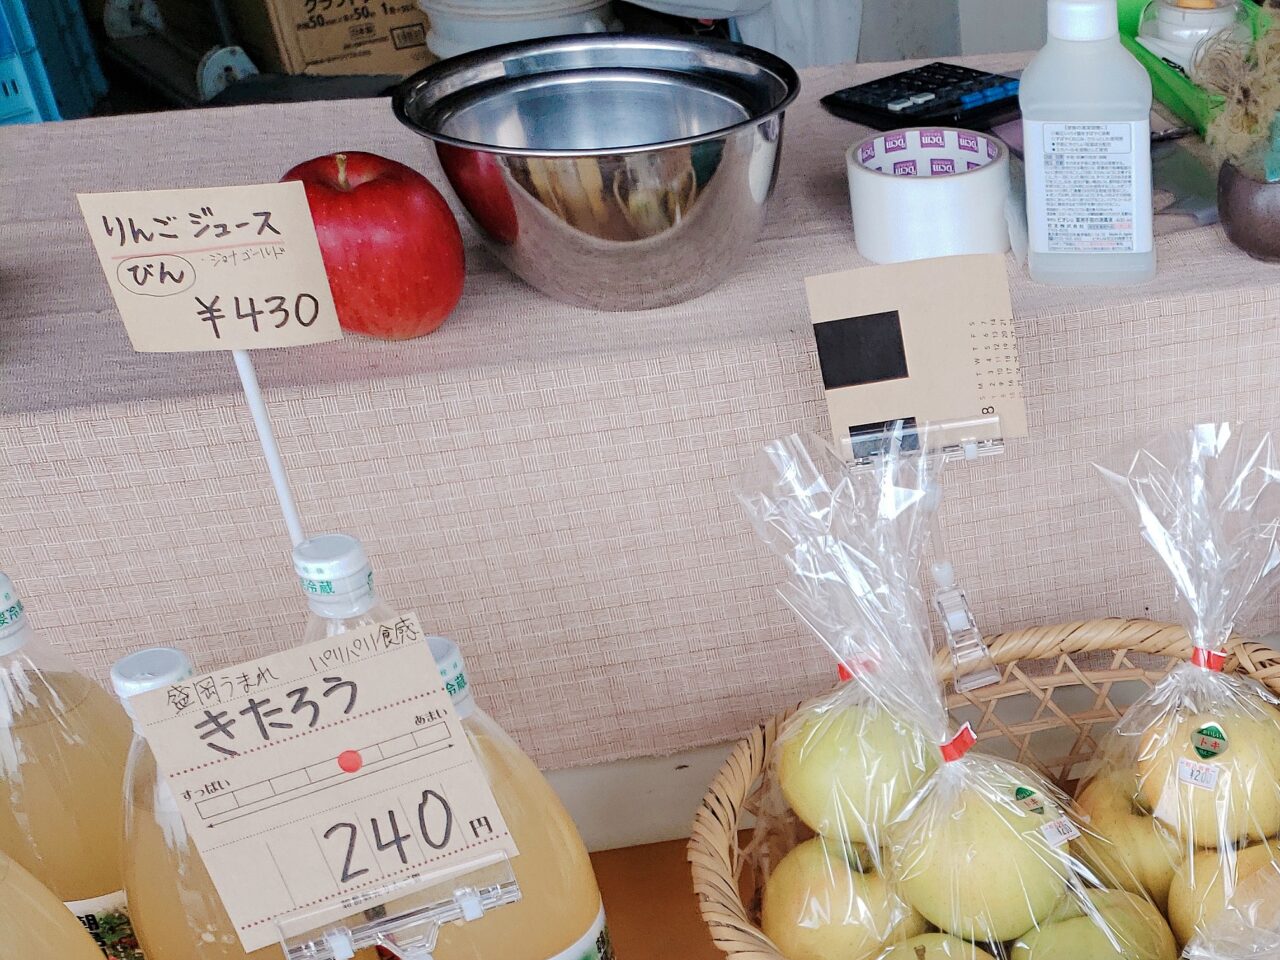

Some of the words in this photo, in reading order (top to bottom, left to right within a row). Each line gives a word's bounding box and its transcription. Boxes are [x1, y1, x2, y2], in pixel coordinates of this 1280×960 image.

[102, 206, 281, 247] りんごジュース
[127, 261, 185, 287] びん
[194, 293, 320, 339] ¥430
[167, 665, 279, 714] 盛岡うまれ
[194, 676, 358, 757] きたろう
[323, 789, 453, 884] 240
[468, 815, 493, 839] 円
